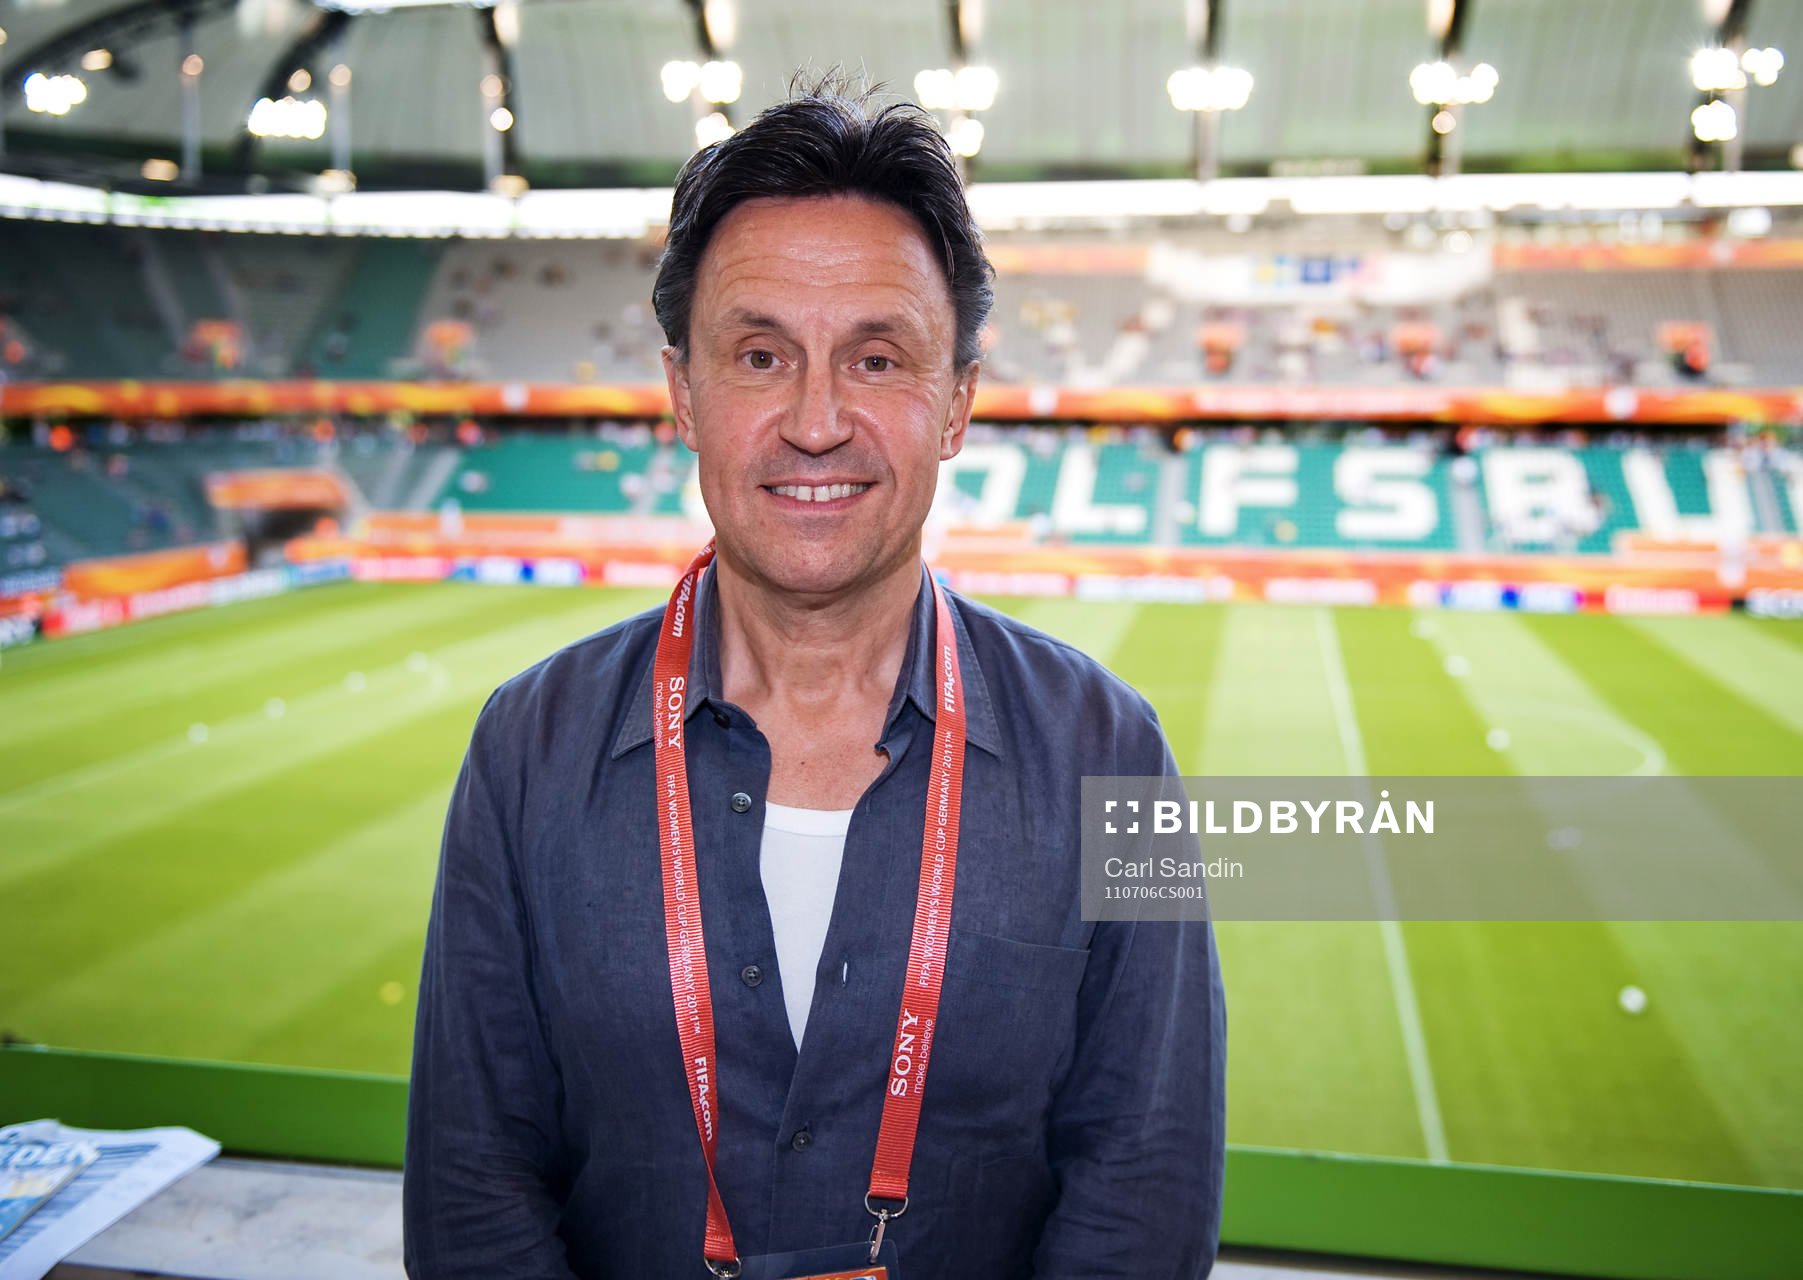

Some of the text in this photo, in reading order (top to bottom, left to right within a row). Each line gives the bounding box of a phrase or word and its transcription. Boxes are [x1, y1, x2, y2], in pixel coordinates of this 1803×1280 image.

[668, 676, 685, 750] SONY
[666, 774, 676, 798] FIFA
[937, 772, 951, 826] GERMANY
[668, 799, 681, 856] WOMEN'S
[935, 829, 947, 852] CUP
[673, 857, 686, 901] WORLD
[931, 854, 945, 897] WORLD
[677, 904, 688, 926] CUP
[923, 898, 940, 960] WOMEN'S
[679, 930, 695, 991] GERMANY
[919, 962, 931, 987] FIFA
[891, 1008, 919, 1097] SONY
